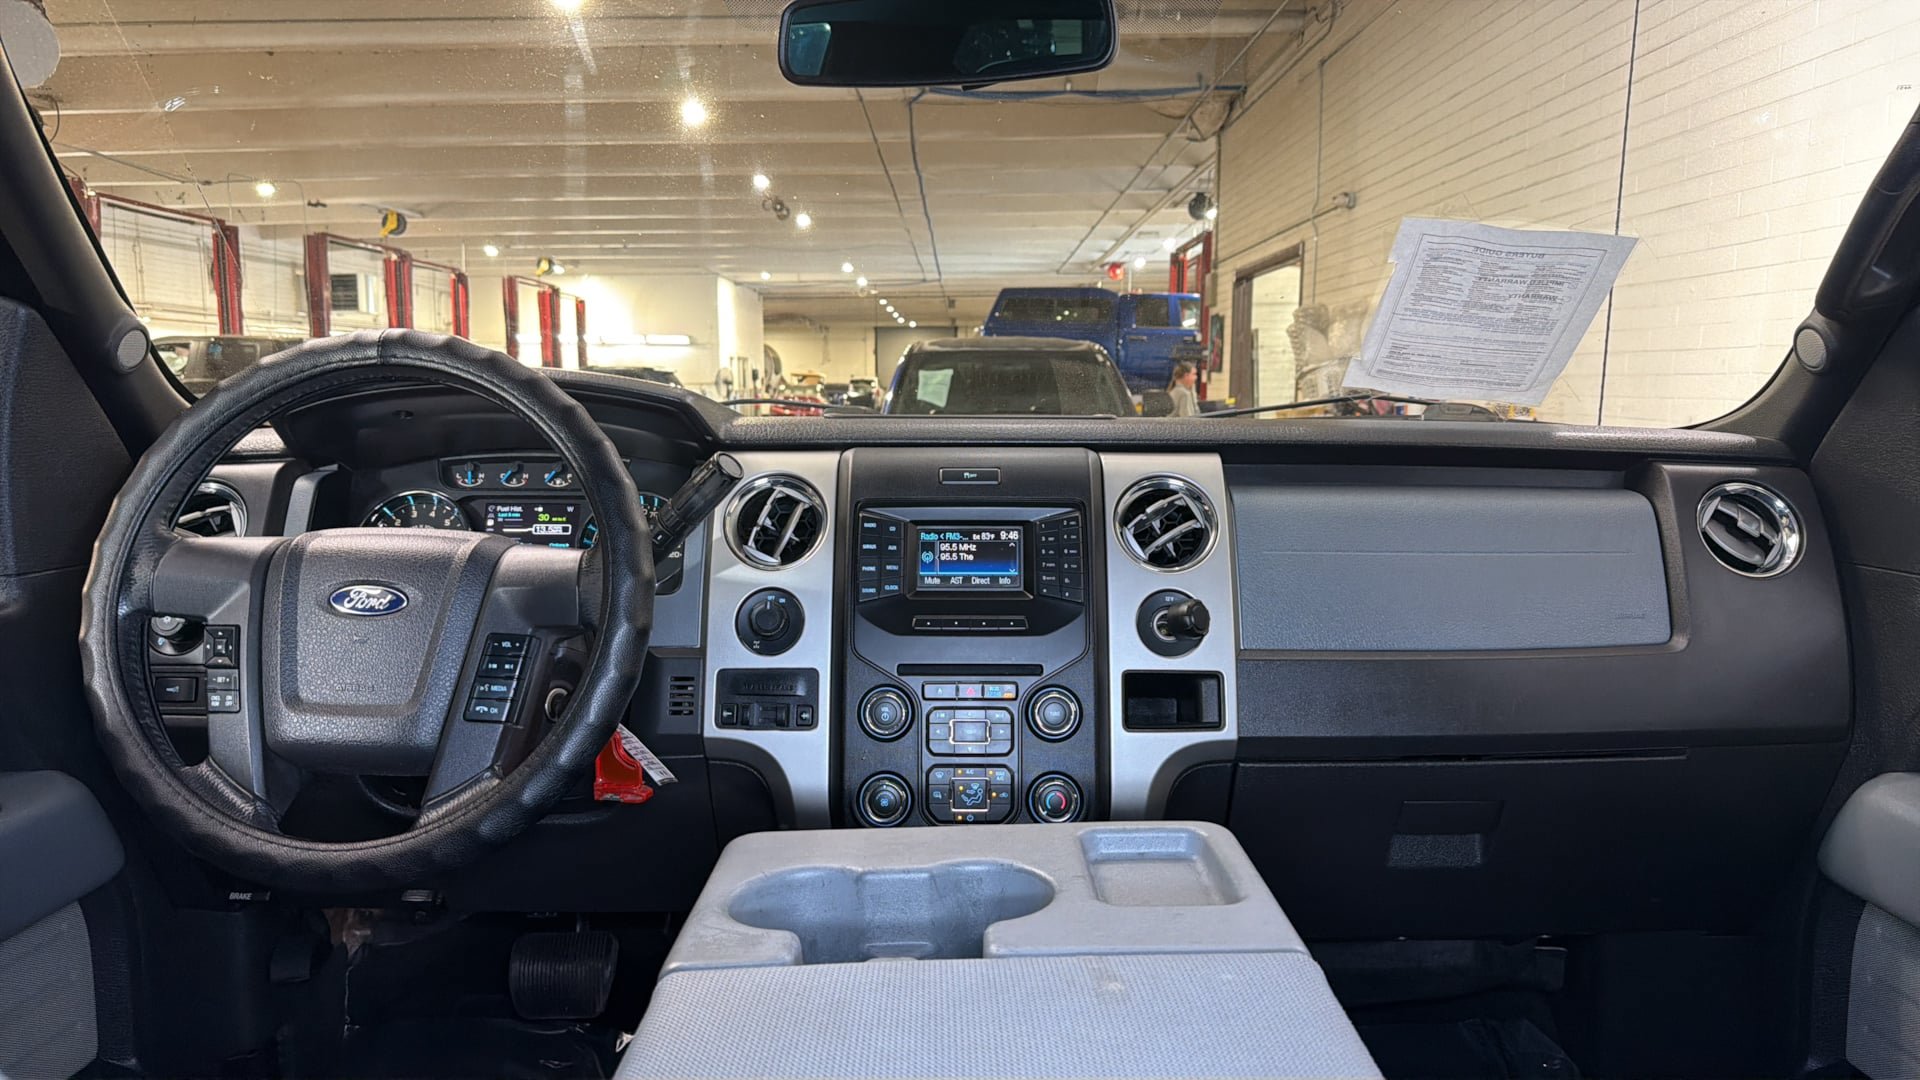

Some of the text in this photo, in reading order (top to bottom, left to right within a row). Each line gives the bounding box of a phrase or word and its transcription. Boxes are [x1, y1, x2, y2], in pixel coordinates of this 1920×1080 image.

[411, 510, 418, 518] 3
[537, 513, 550, 521] 30
[920, 532, 939, 540] Radio
[1000, 530, 1019, 540] 9:46
[940, 543, 977, 551] 95.5 MHz
[940, 553, 974, 561] 95.5 The
[924, 576, 1011, 585] Mute AST Direct Info
[343, 588, 393, 610] Ford
[229, 892, 252, 901] BRAKE
